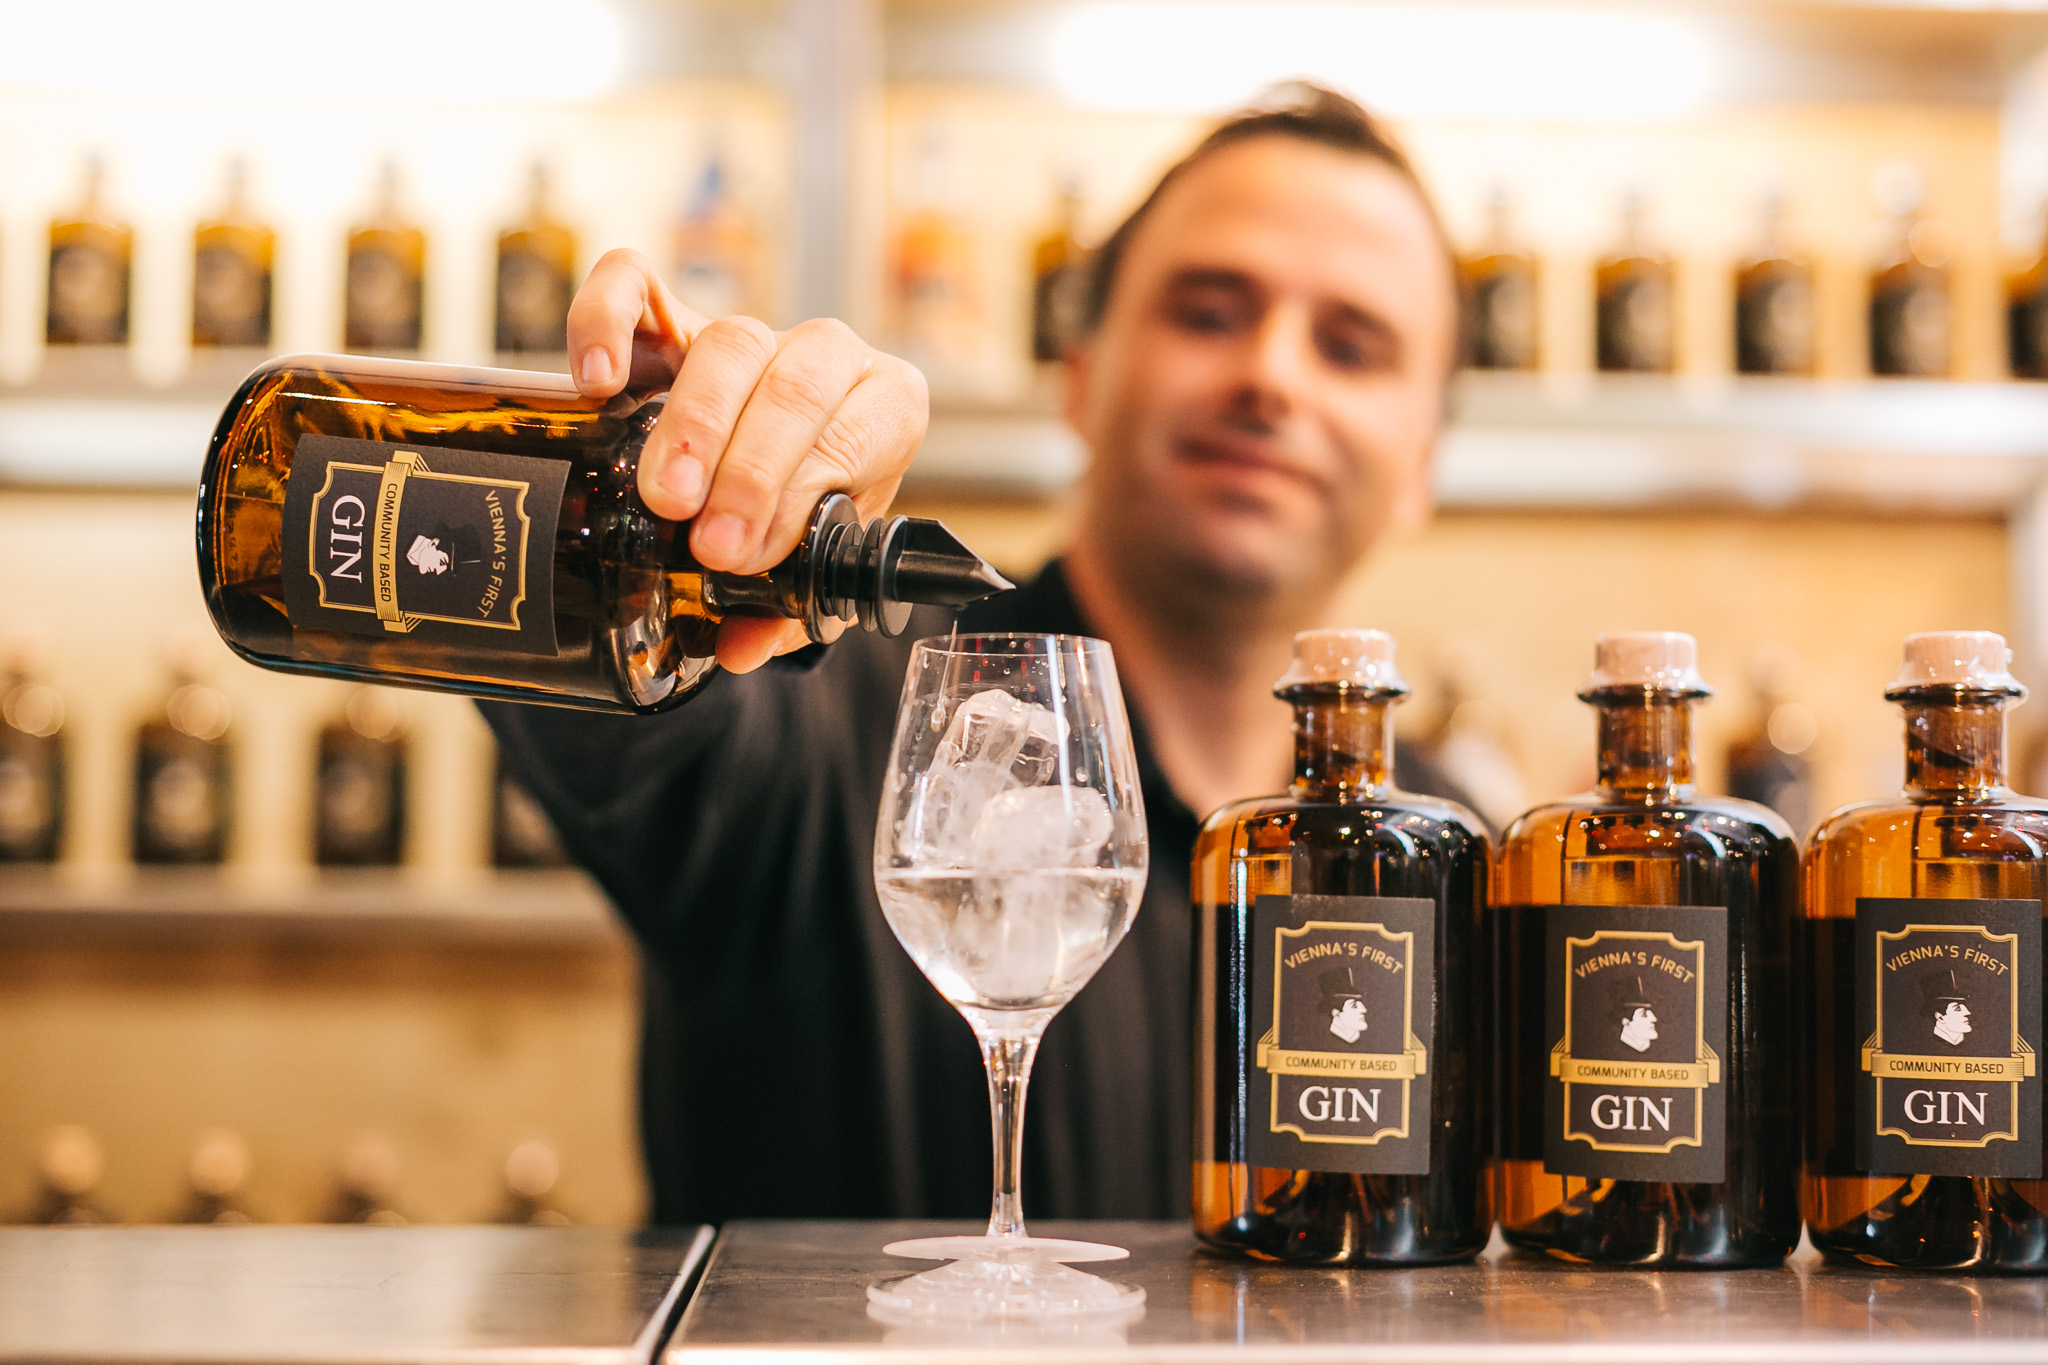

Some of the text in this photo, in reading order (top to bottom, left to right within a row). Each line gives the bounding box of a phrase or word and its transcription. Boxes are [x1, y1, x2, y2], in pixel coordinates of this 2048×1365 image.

[330, 495, 365, 583] GIN
[380, 483, 397, 602] COMMUNITY BASED
[477, 490, 506, 618] VIENNA'S FIRST
[1284, 942, 1403, 974] VIENNA'S FIRST
[1575, 951, 1695, 983] VIENNA'S FIRST
[1886, 945, 2008, 975] VIENNA'S FIRST
[1285, 1056, 1397, 1071] COMMUNITY BASED
[1577, 1065, 1689, 1081] COMMUNITY BASED
[1890, 1061, 2004, 1074] COMMUNITY BASED
[1299, 1086, 1382, 1123] GIN
[1591, 1094, 1673, 1131] GIN
[1904, 1090, 1988, 1125] GIN
